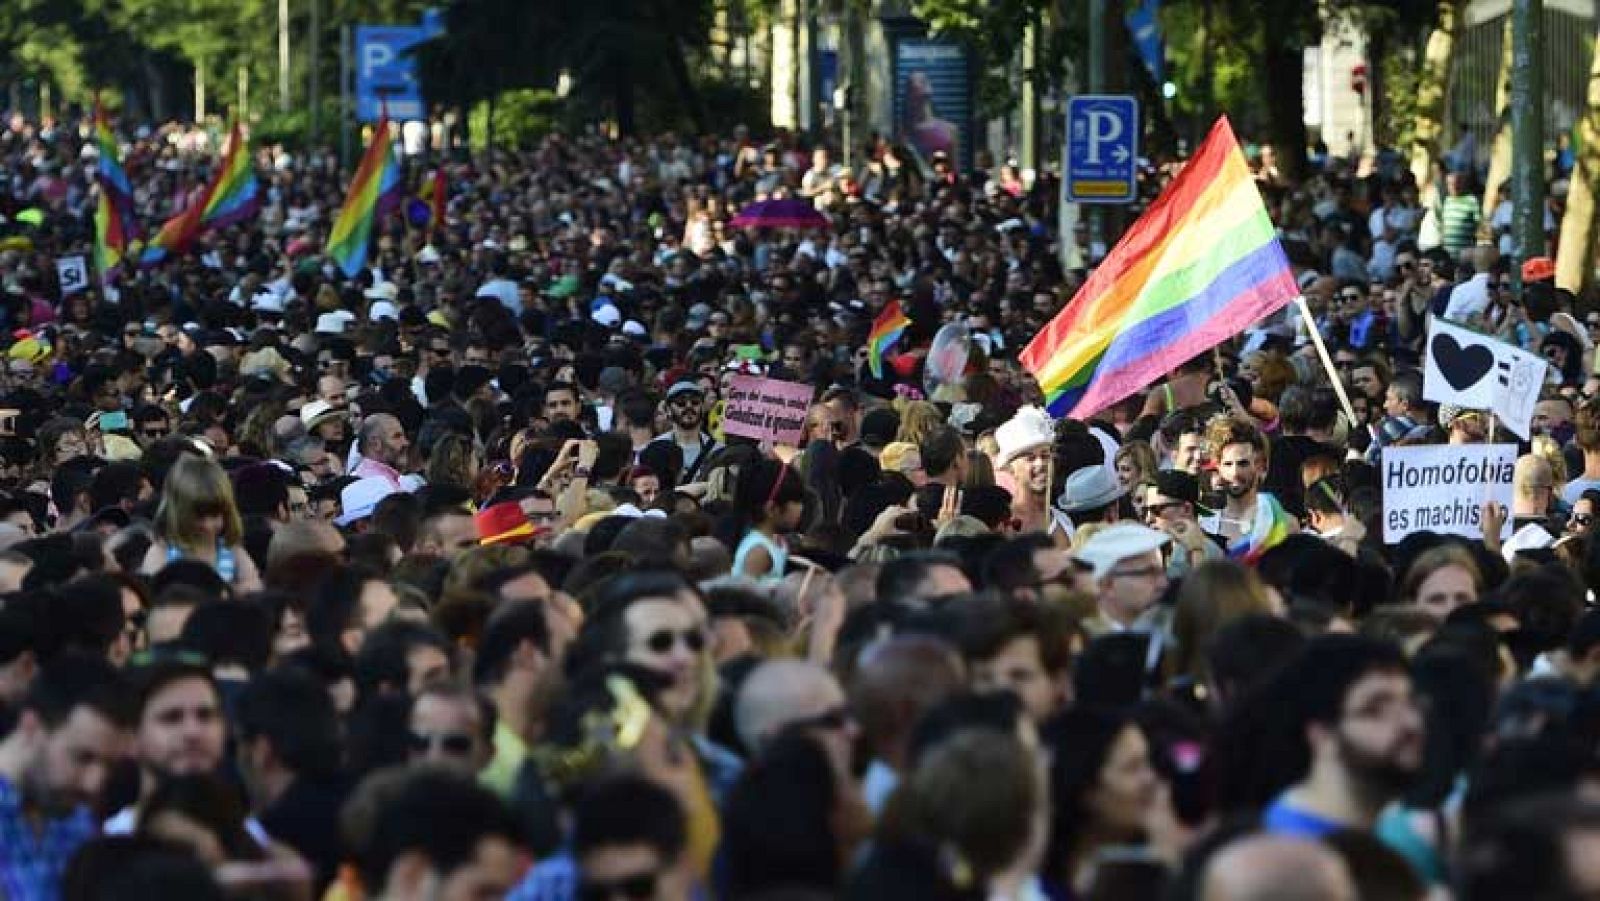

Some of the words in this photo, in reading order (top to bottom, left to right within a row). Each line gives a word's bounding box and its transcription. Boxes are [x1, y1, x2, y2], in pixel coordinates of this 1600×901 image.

[362, 43, 392, 78] P
[1082, 110, 1123, 164] P
[1387, 456, 1514, 489] Homofobia
[1389, 508, 1409, 530] es
